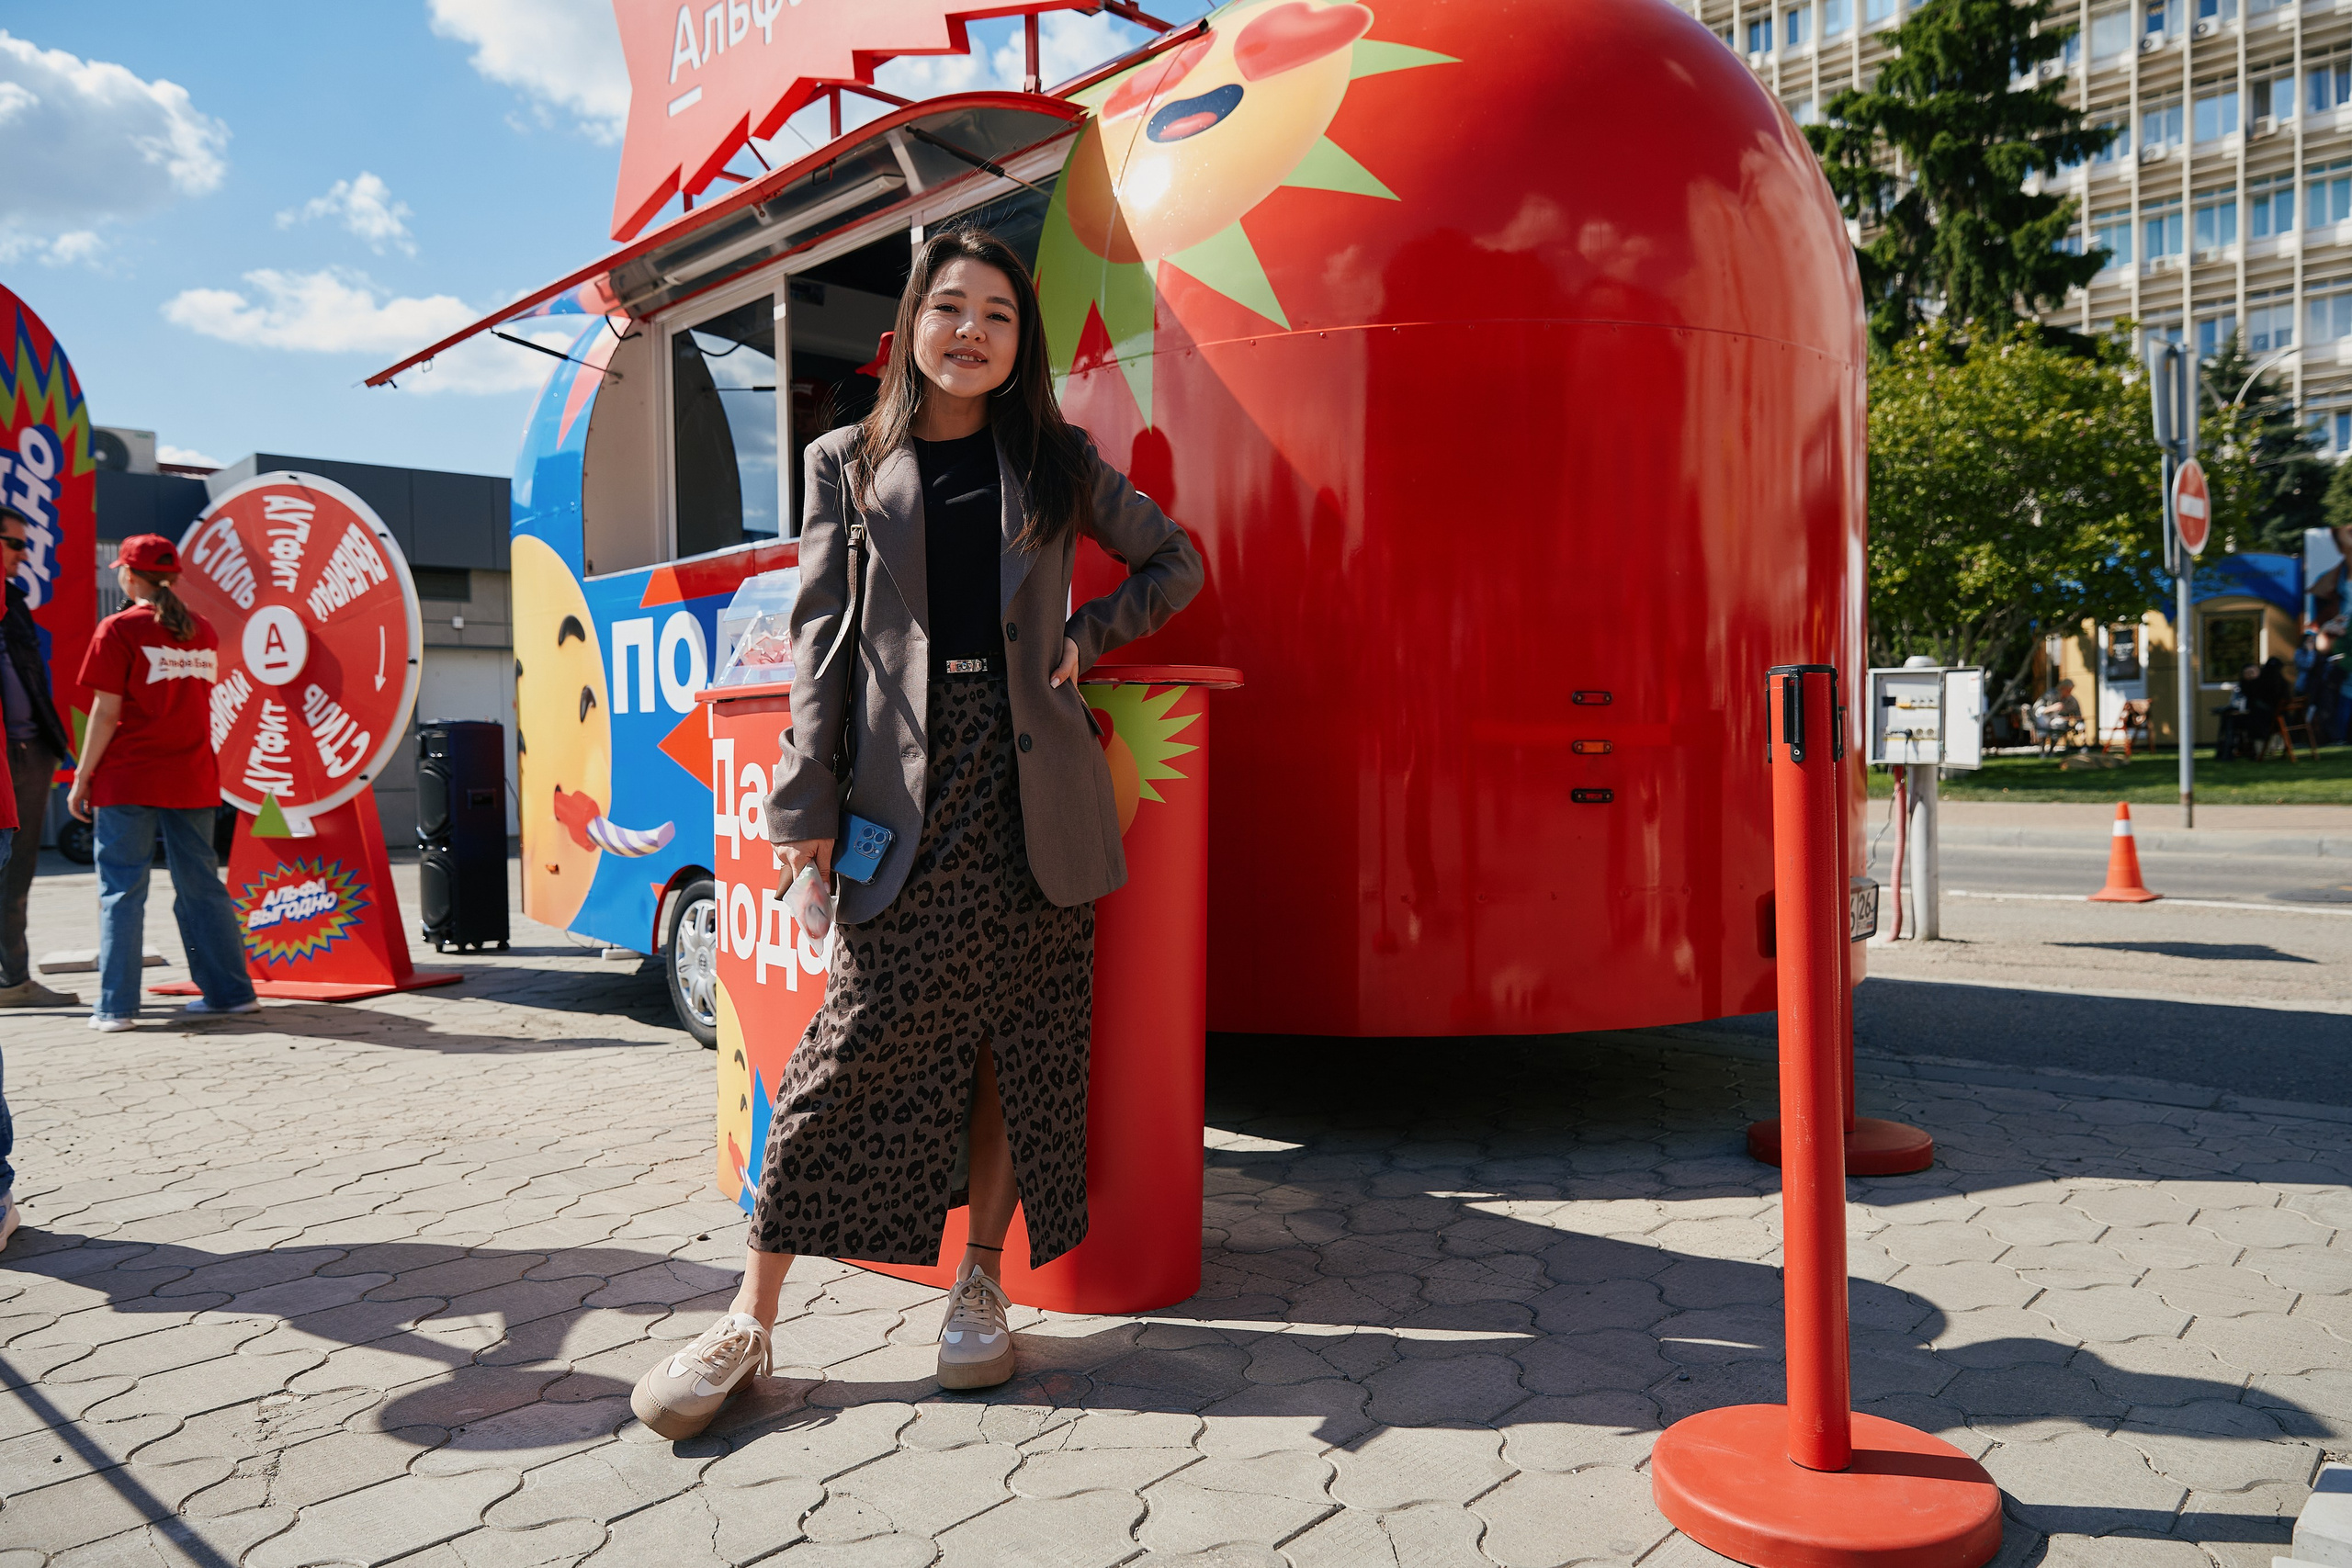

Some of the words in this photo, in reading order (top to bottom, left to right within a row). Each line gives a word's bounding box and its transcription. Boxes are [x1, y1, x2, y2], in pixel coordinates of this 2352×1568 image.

[669, 0, 802, 85] Альф
[192, 516, 257, 610] СТИЛЬ
[263, 495, 316, 593] АУТФИТ
[306, 523, 389, 623] ВЫБИРАЙ
[243, 698, 295, 796] АУТФИТ
[303, 683, 371, 779] СТИЛЬ
[713, 739, 781, 870] Да
[247, 892, 337, 928] ВЫГОДНО
[261, 877, 326, 908] АЛЬФА
